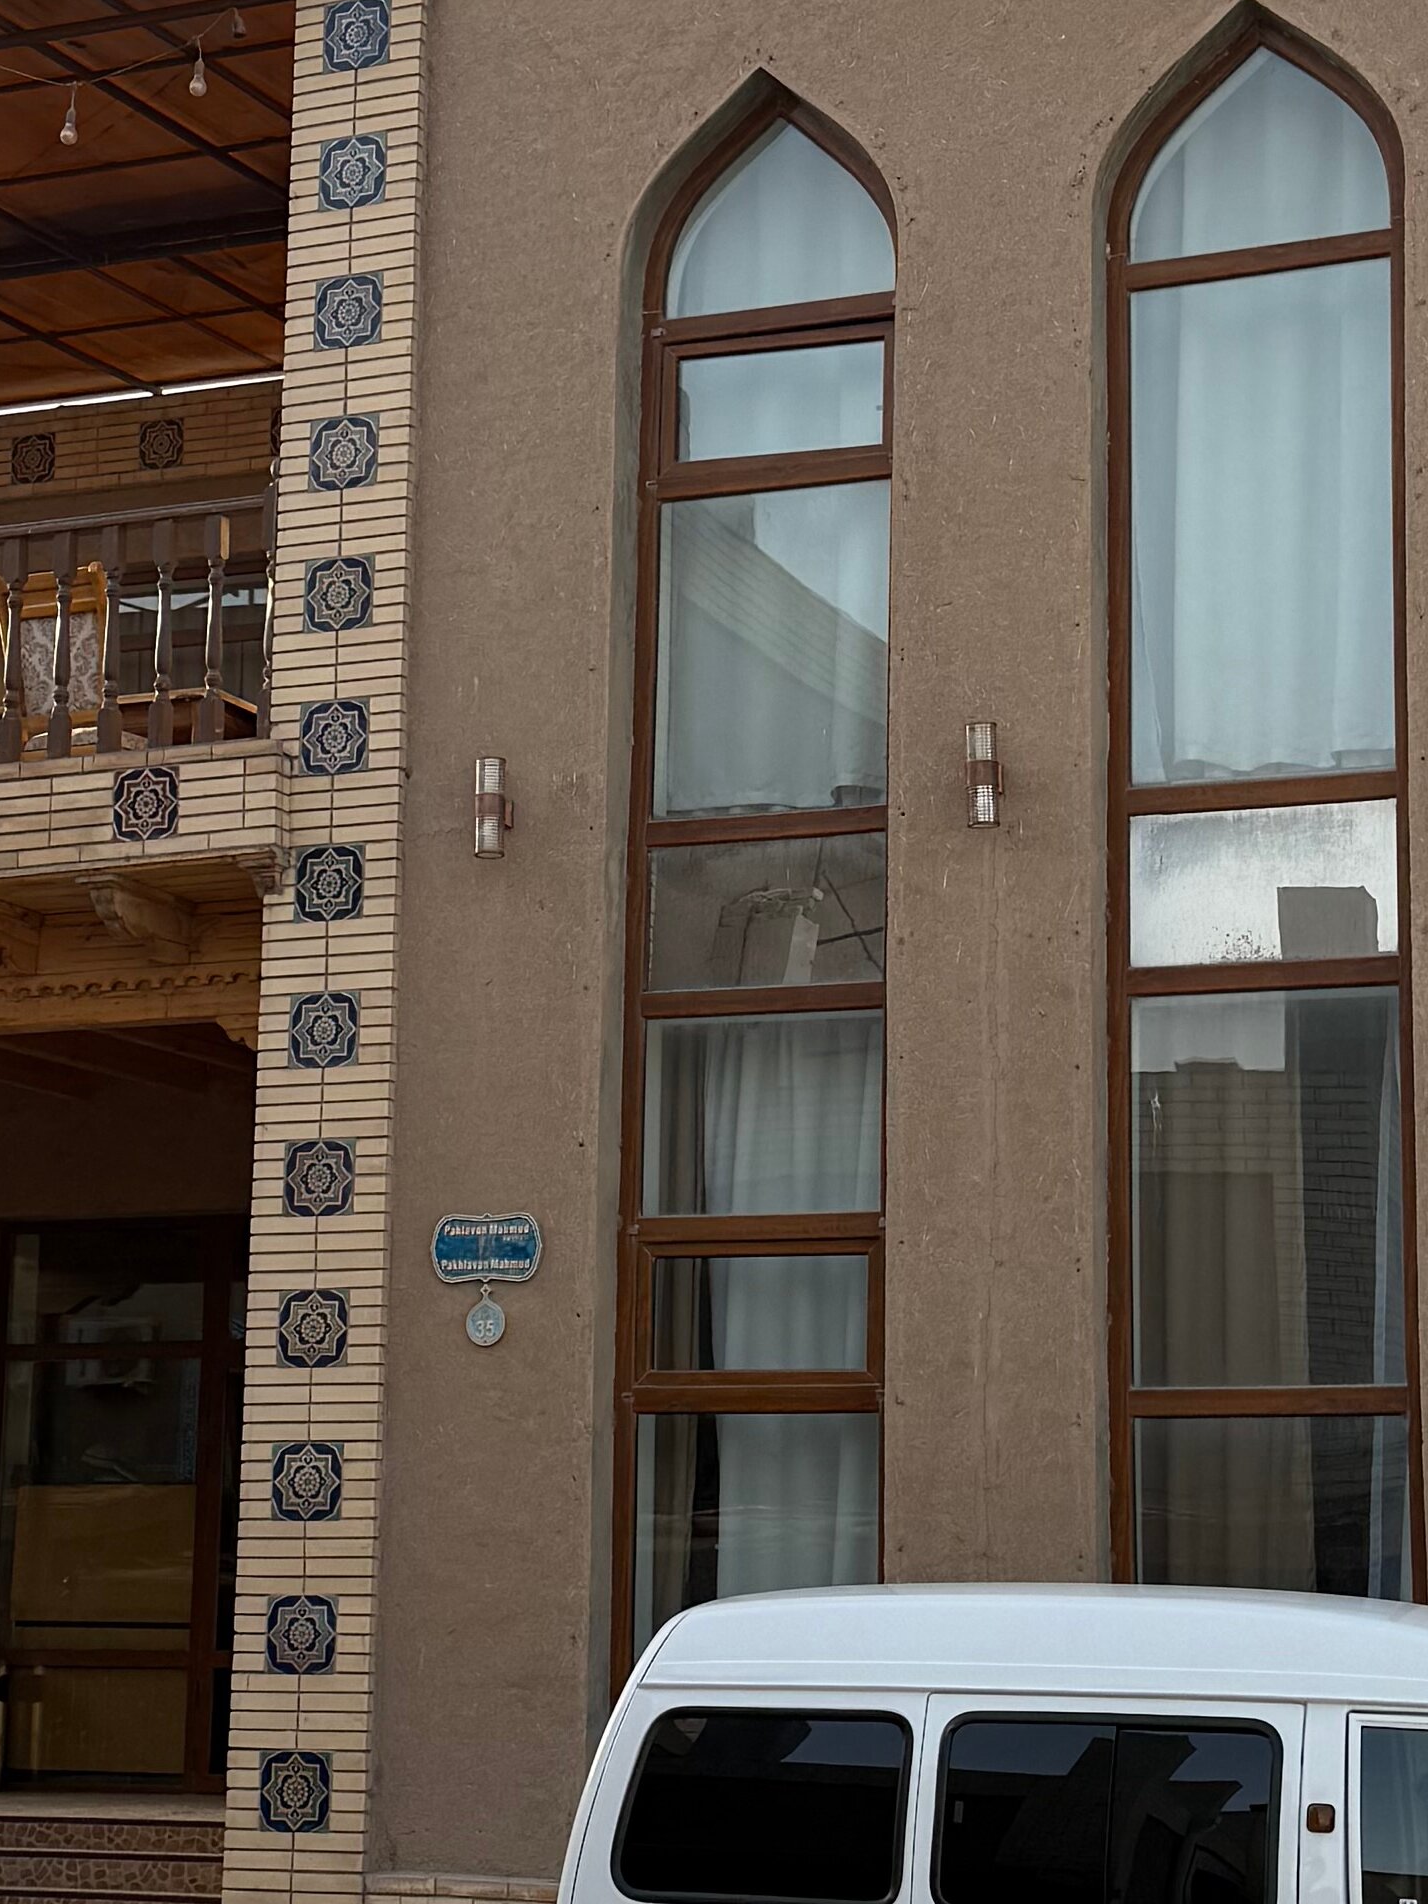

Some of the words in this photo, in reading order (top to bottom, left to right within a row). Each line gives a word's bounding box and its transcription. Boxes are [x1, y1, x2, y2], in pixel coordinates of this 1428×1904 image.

[489, 1223, 530, 1235] Mahmud
[490, 1258, 531, 1269] Mahmud
[475, 1319, 495, 1338] 35
